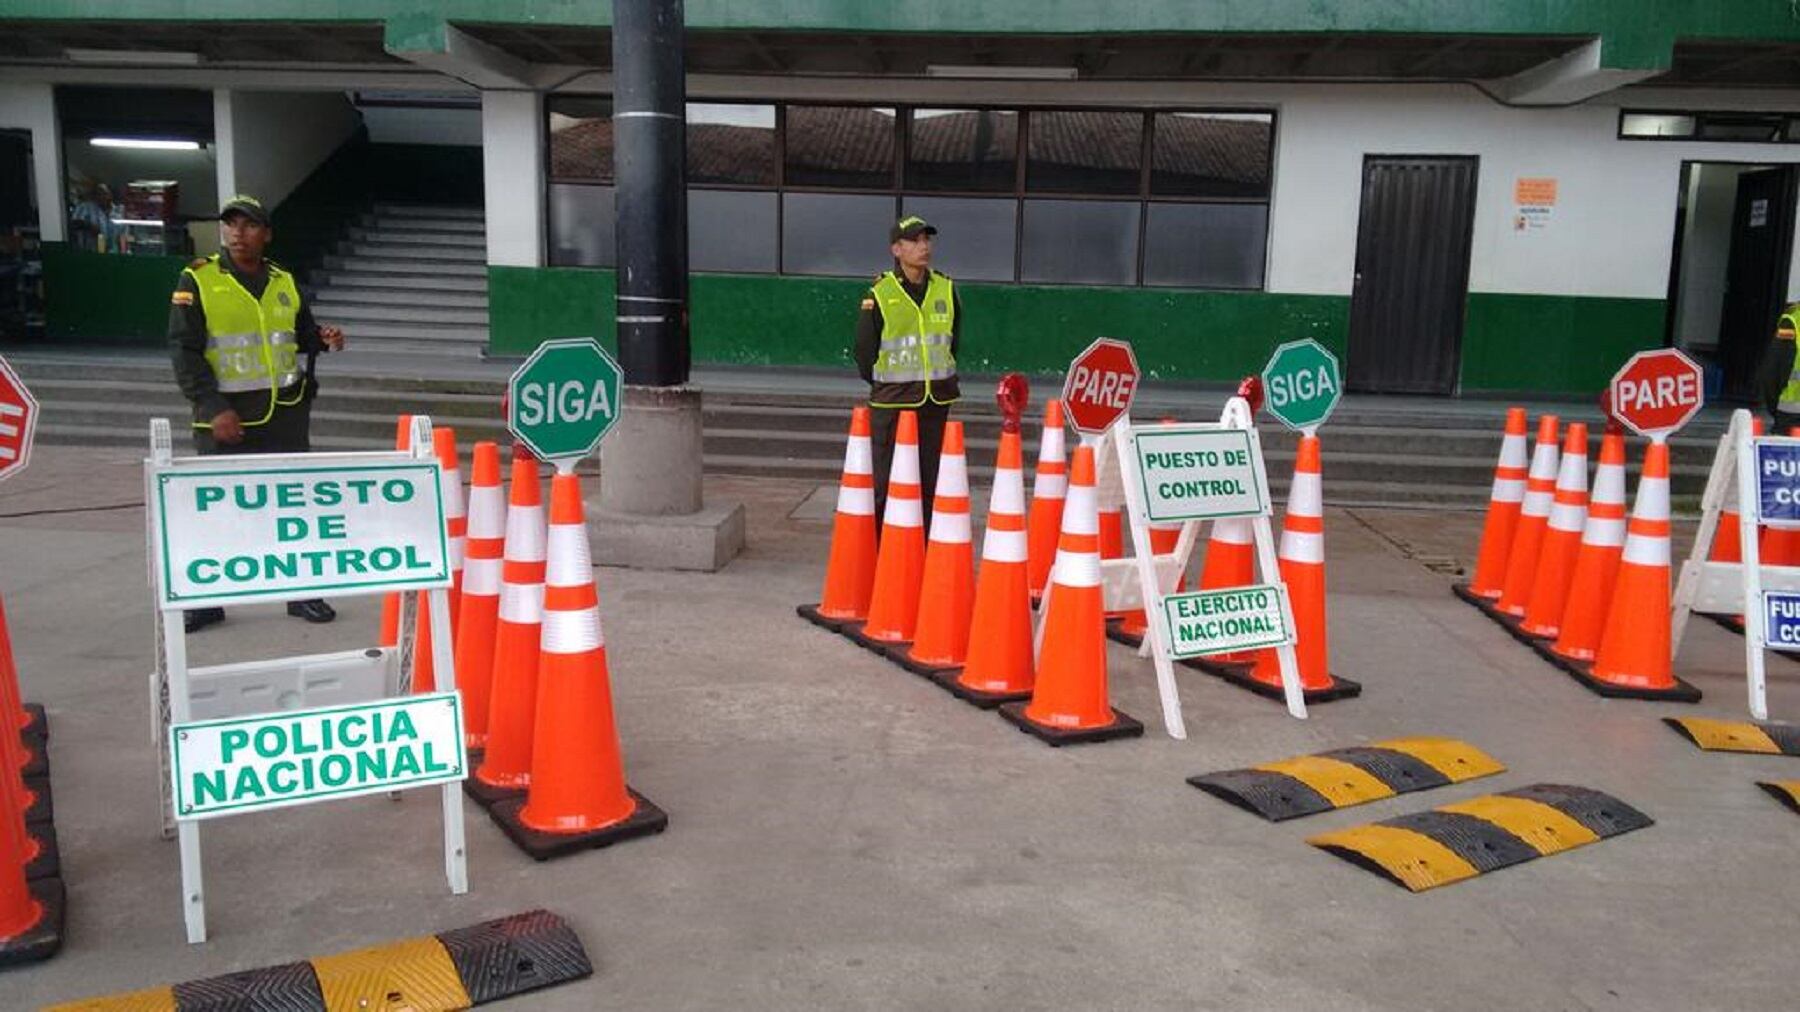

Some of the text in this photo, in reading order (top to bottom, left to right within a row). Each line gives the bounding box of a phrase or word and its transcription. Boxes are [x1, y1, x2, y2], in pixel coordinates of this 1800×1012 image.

[520, 379, 612, 426] SIGA
[1069, 366, 1135, 409] PARE
[1270, 366, 1335, 406] SIGA
[1618, 372, 1697, 412] PARE
[1146, 450, 1247, 469] PUESTO DE
[1764, 460, 1800, 477] PU
[195, 479, 415, 512] PUESTO
[1158, 479, 1246, 499] CONTROL
[276, 515, 347, 542] DE
[186, 545, 432, 584] CONTROL
[1177, 592, 1268, 618] EJERCITO
[1179, 616, 1275, 641] NACIONAL
[220, 710, 418, 764] POLICIA
[192, 742, 448, 806] NACIONAL
